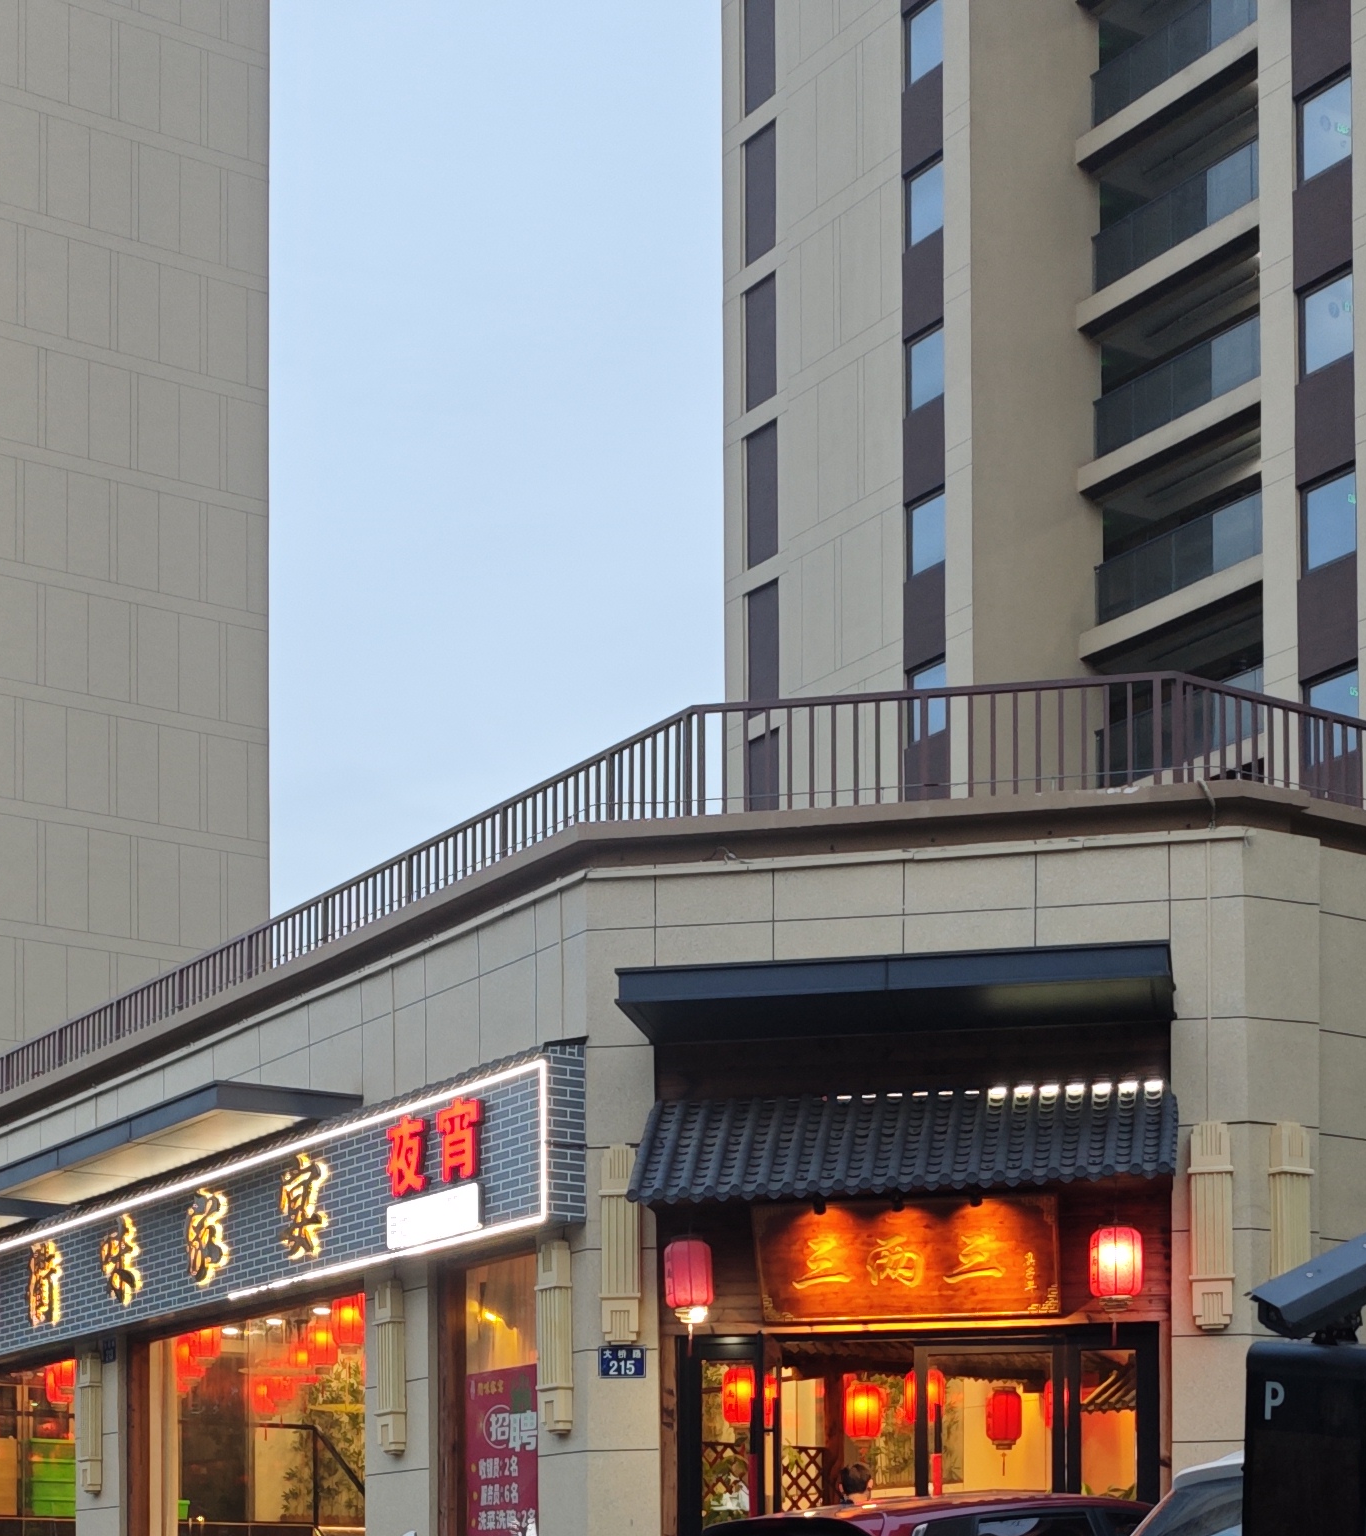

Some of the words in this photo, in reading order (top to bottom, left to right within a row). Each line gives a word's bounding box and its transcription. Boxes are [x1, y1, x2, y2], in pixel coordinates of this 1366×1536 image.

[387, 1097, 480, 1198] 夜宵
[609, 1360, 635, 1375] 215
[1264, 1381, 1285, 1420] P
[490, 1410, 538, 1452] 招聘
